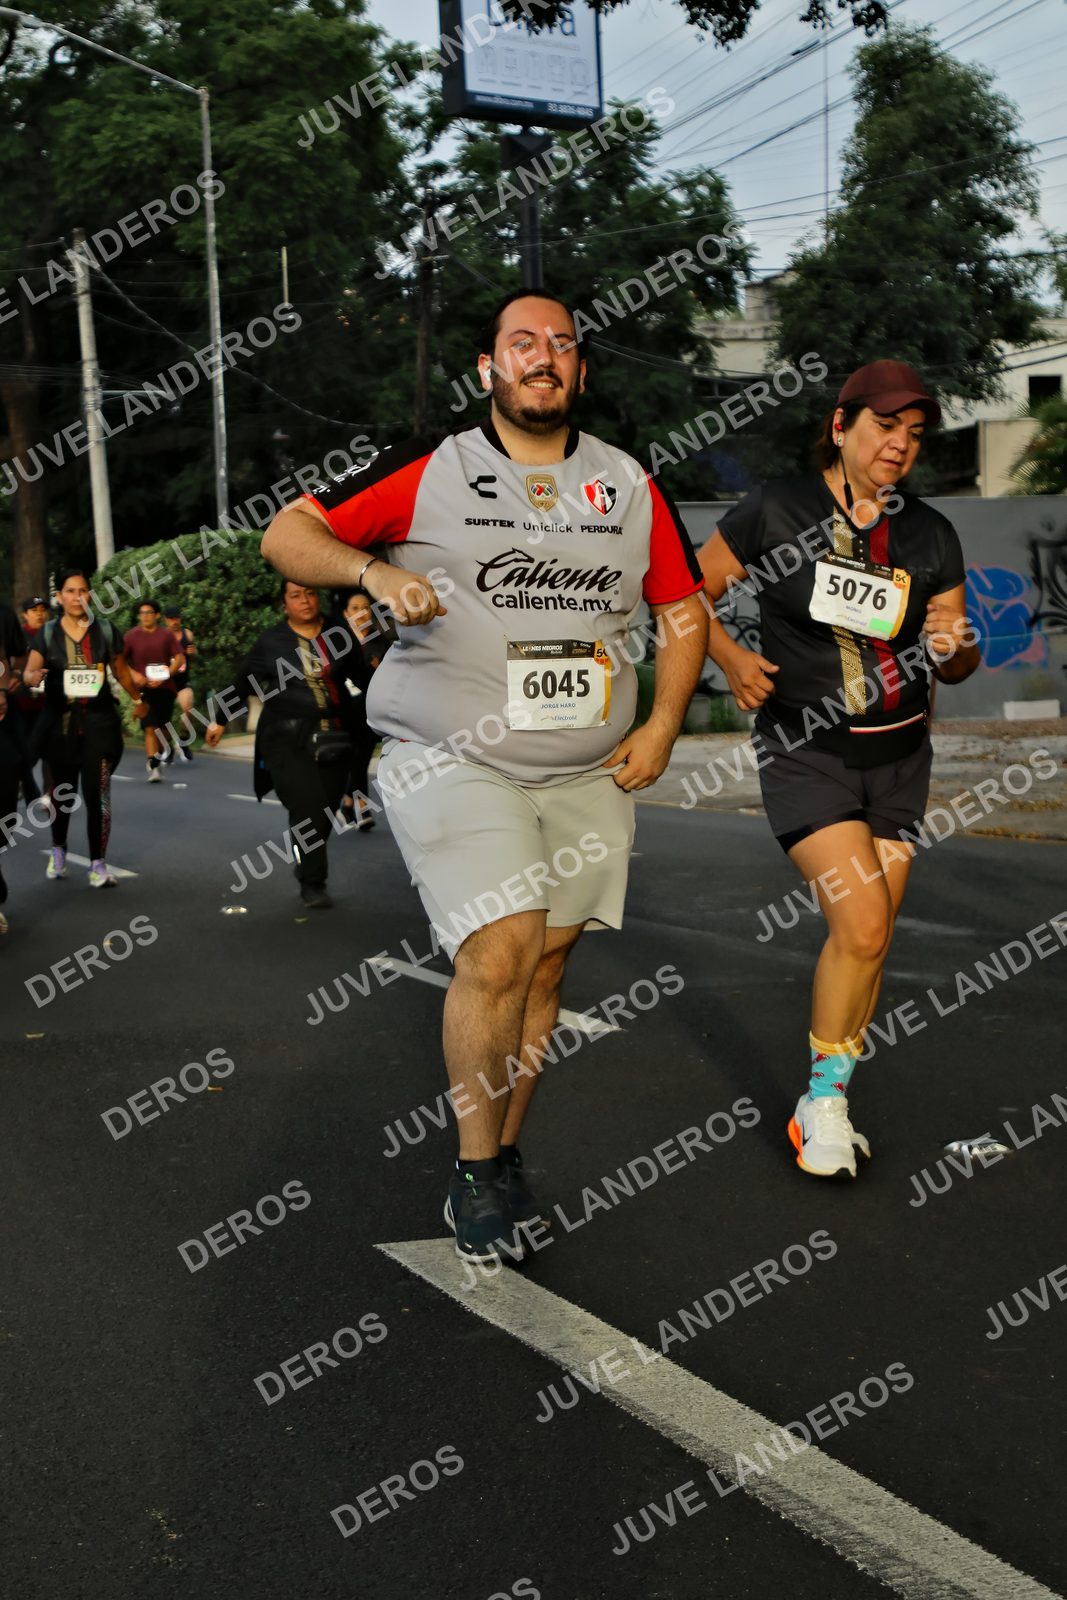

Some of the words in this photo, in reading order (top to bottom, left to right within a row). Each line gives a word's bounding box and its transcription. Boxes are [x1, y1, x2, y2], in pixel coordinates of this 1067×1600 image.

[465, 518, 515, 528] SURTEK
[523, 522, 574, 534] Uniclick
[581, 525, 623, 535] PERDURA
[475, 548, 622, 593] Caliente
[492, 590, 612, 612] caliente.mx
[826, 573, 887, 611] 5076
[71, 674, 97, 684] 5052
[522, 669, 591, 699] 6045
